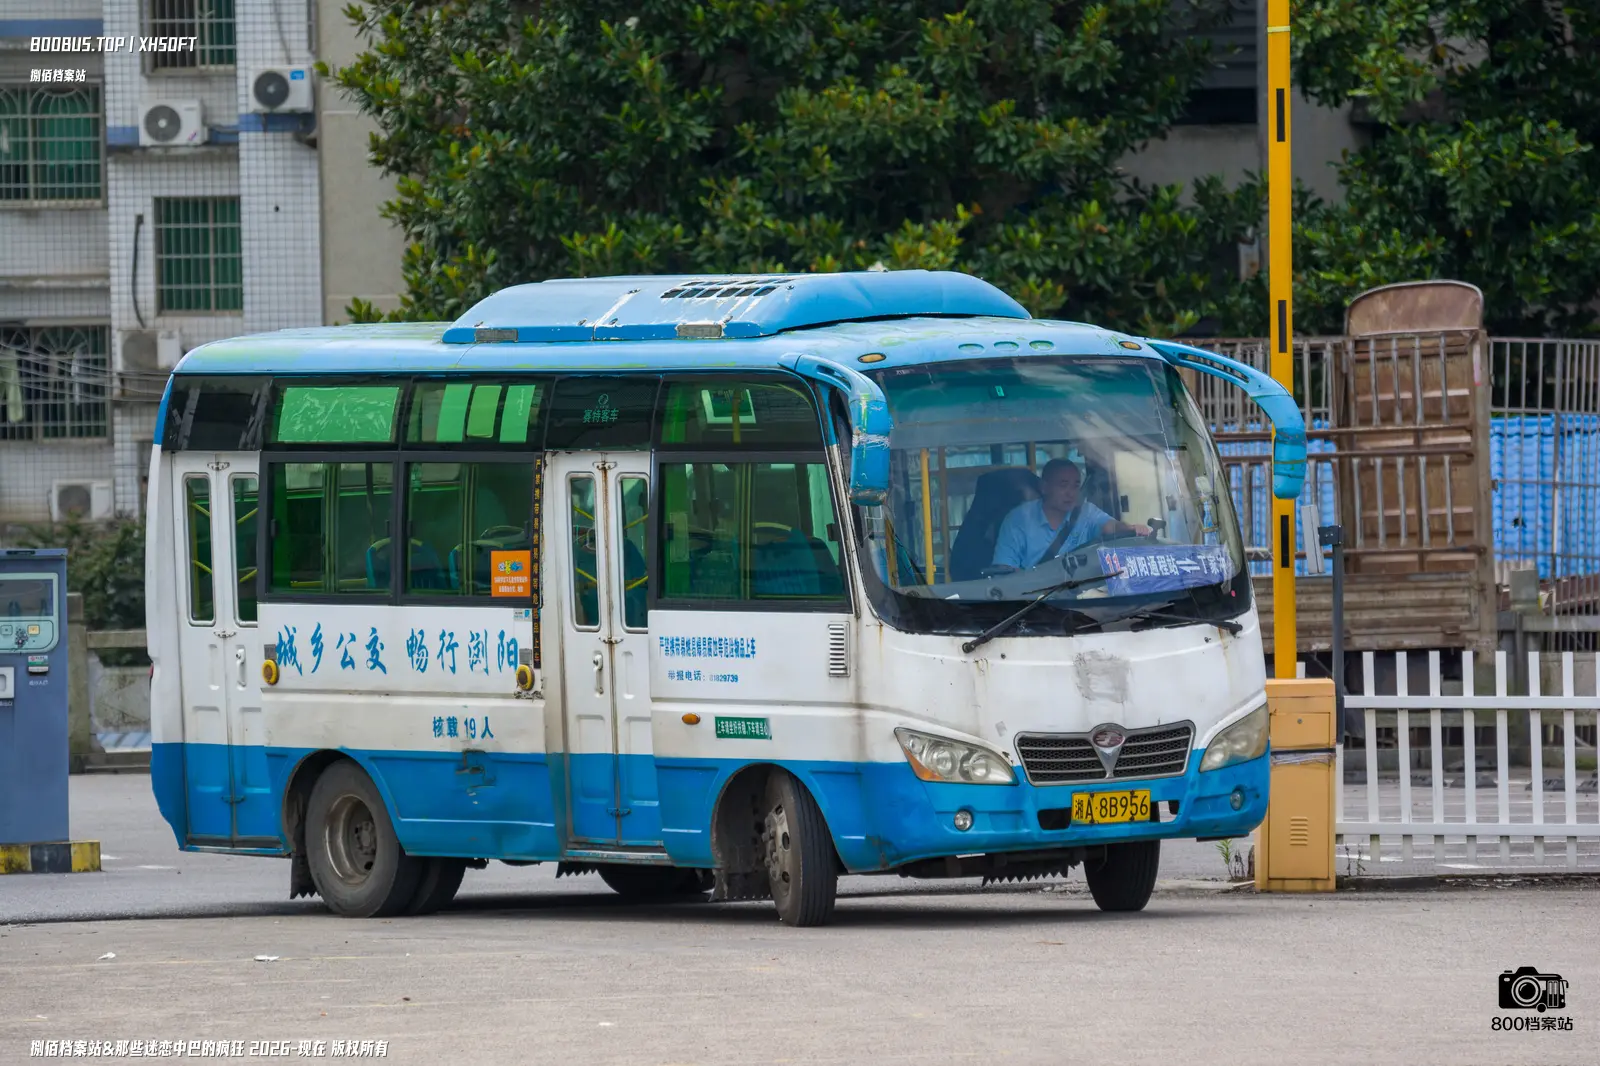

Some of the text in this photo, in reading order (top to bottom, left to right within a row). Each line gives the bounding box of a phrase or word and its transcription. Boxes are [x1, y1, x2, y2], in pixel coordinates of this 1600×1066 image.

[275, 621, 519, 676] 城乡公交 畅行浏阳
